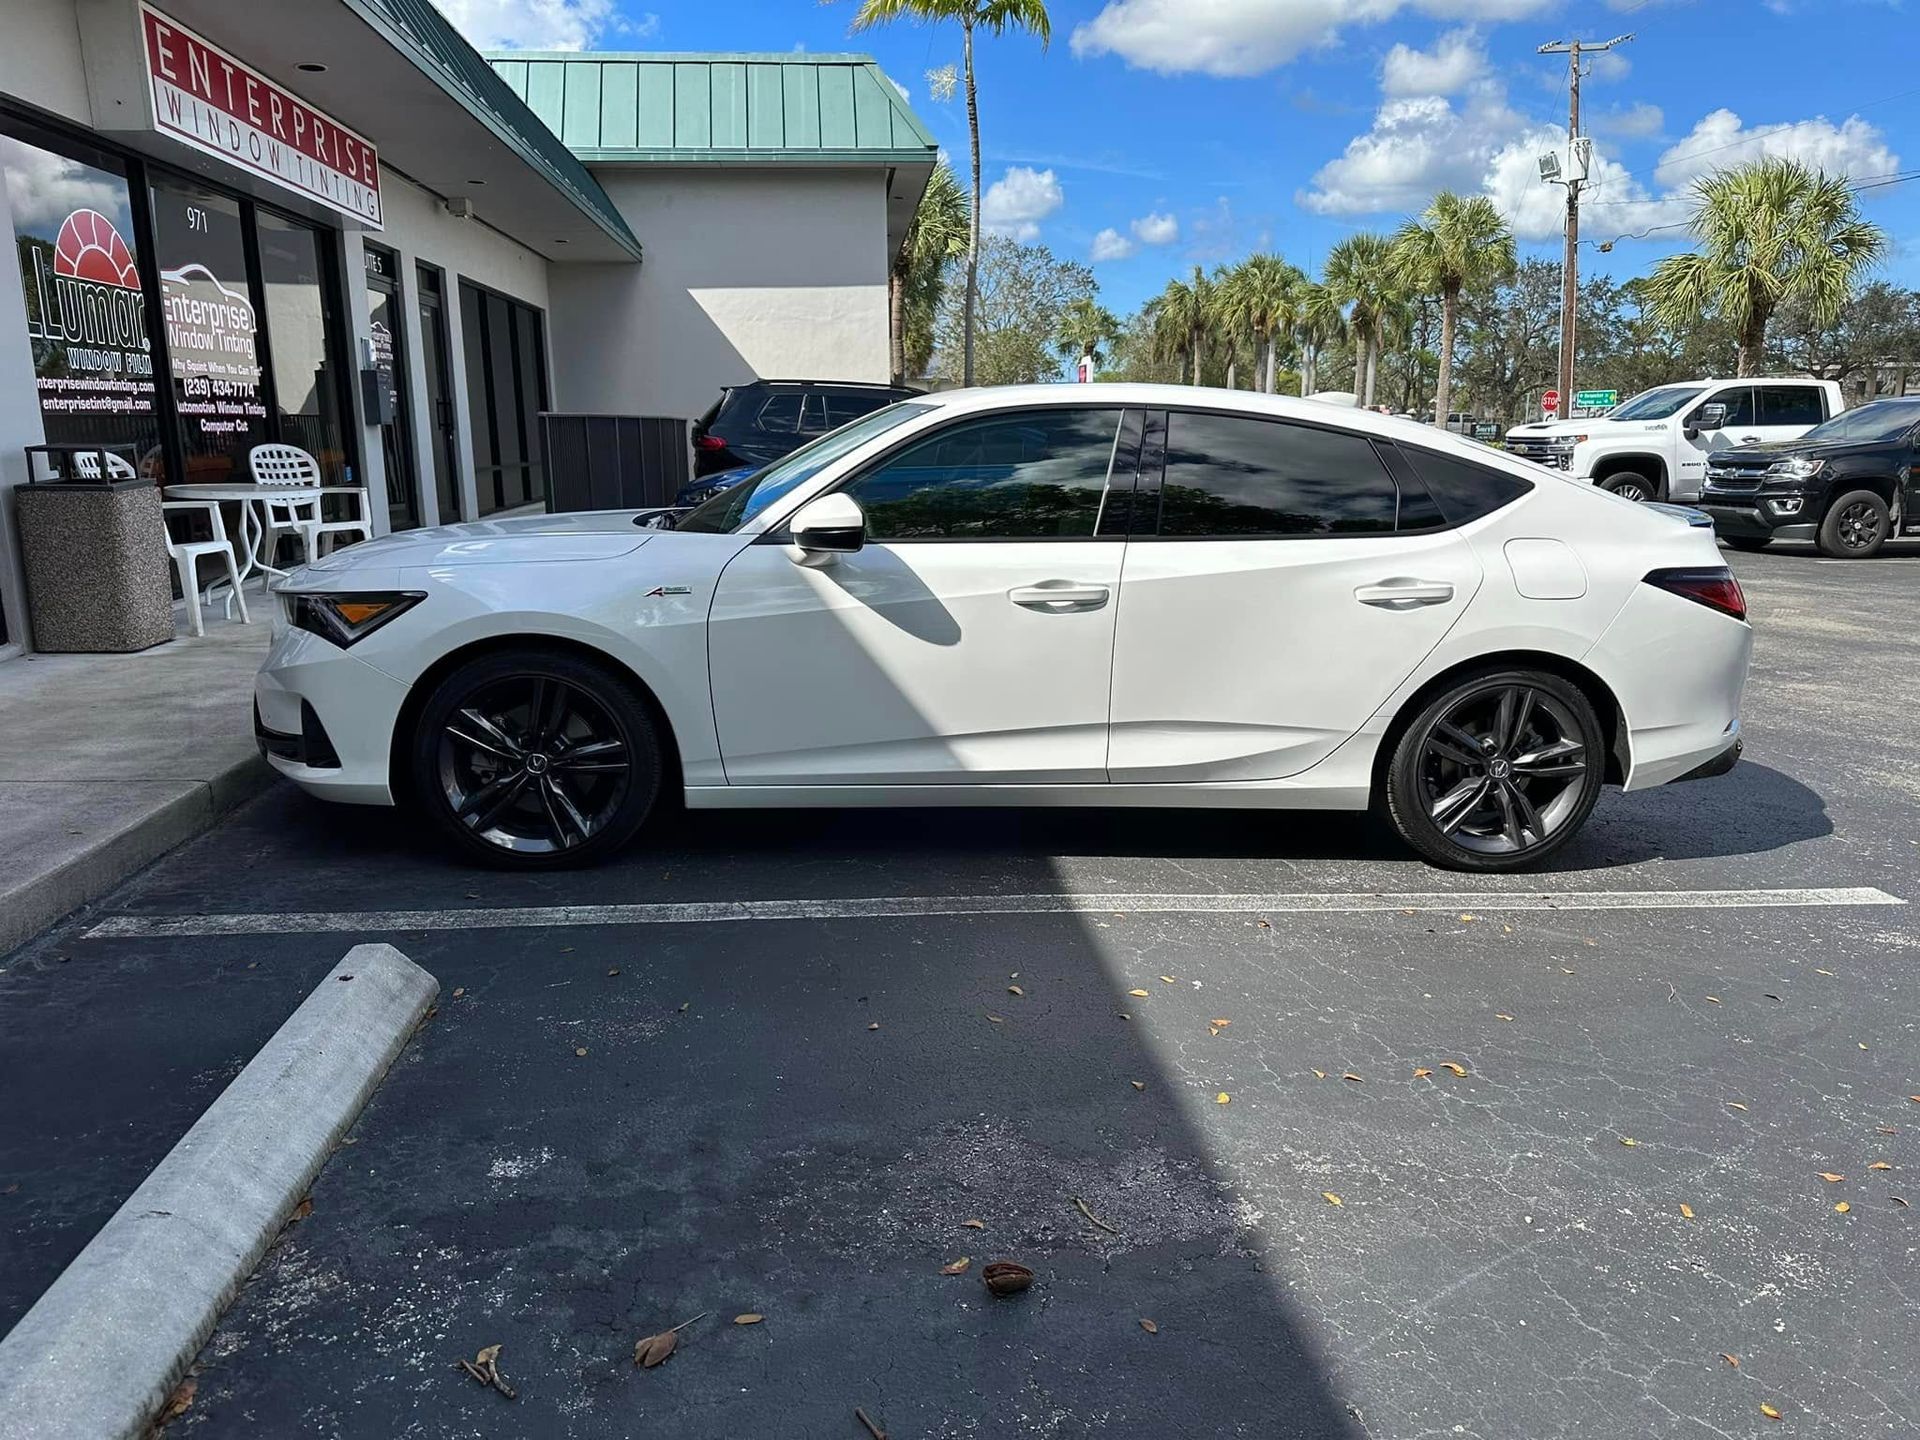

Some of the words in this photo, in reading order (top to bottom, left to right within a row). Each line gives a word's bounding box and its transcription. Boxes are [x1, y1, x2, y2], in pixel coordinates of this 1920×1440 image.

[155, 22, 374, 185] ENTERPRISE
[164, 86, 281, 171] WINDOW
[296, 155, 376, 216] TINTING
[186, 206, 208, 233] 971
[216, 329, 254, 359] Tinting
[66, 347, 121, 372] WINDOW
[125, 353, 153, 375] FILM
[186, 360, 207, 374] Squint
[208, 361, 226, 374] When
[226, 363, 237, 375] You
[238, 365, 249, 375] Can
[36, 376, 155, 395] nterprisewindowtinting.com
[183, 378, 211, 398] (239)
[212, 381, 255, 398] 434-7774
[43, 396, 151, 413] enterprisetint@gmail.com
[216, 400, 243, 414] Window
[243, 402, 266, 418] Tinting
[200, 418, 235, 435] Computer
